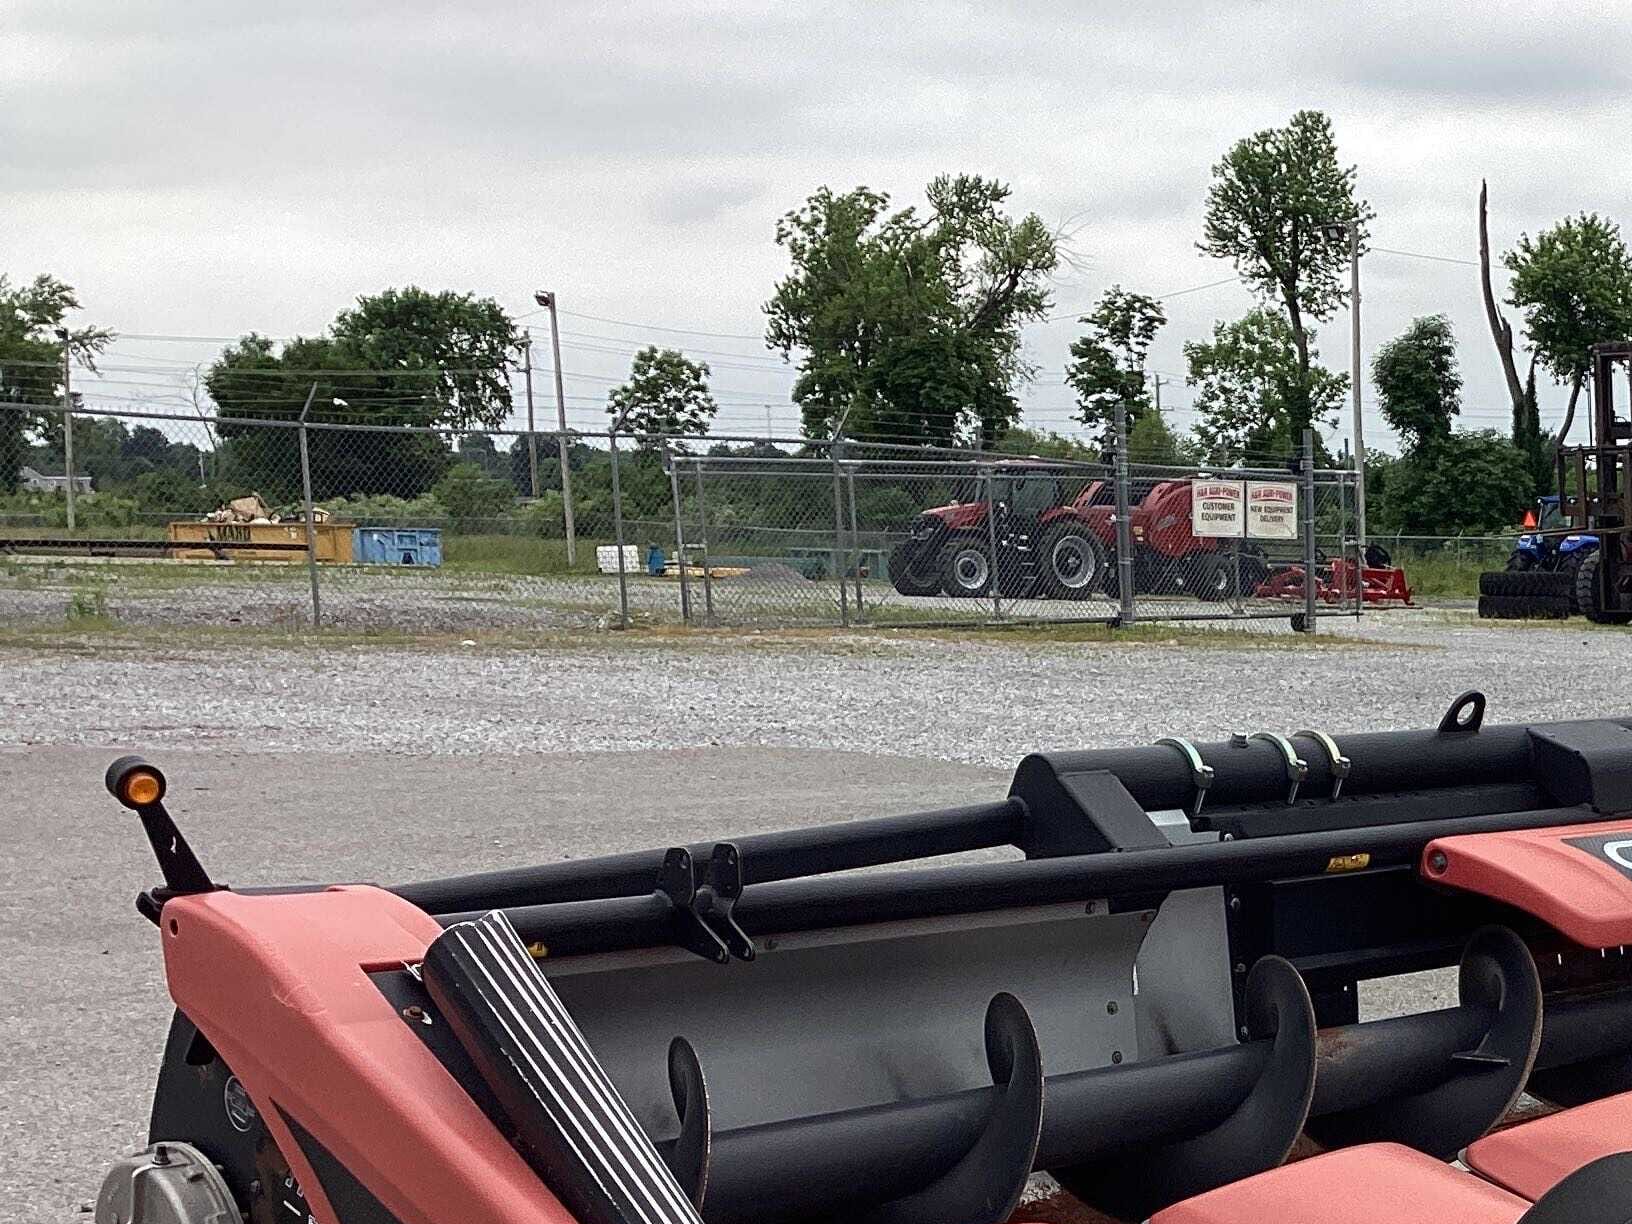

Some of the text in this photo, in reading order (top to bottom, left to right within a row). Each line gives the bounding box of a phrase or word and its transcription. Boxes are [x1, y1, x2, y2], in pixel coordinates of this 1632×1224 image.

[1202, 502, 1235, 511] CUSTOMER
[1250, 505, 1294, 514] NEW EQUIPMENT
[1201, 513, 1236, 522] EQUIPMENT
